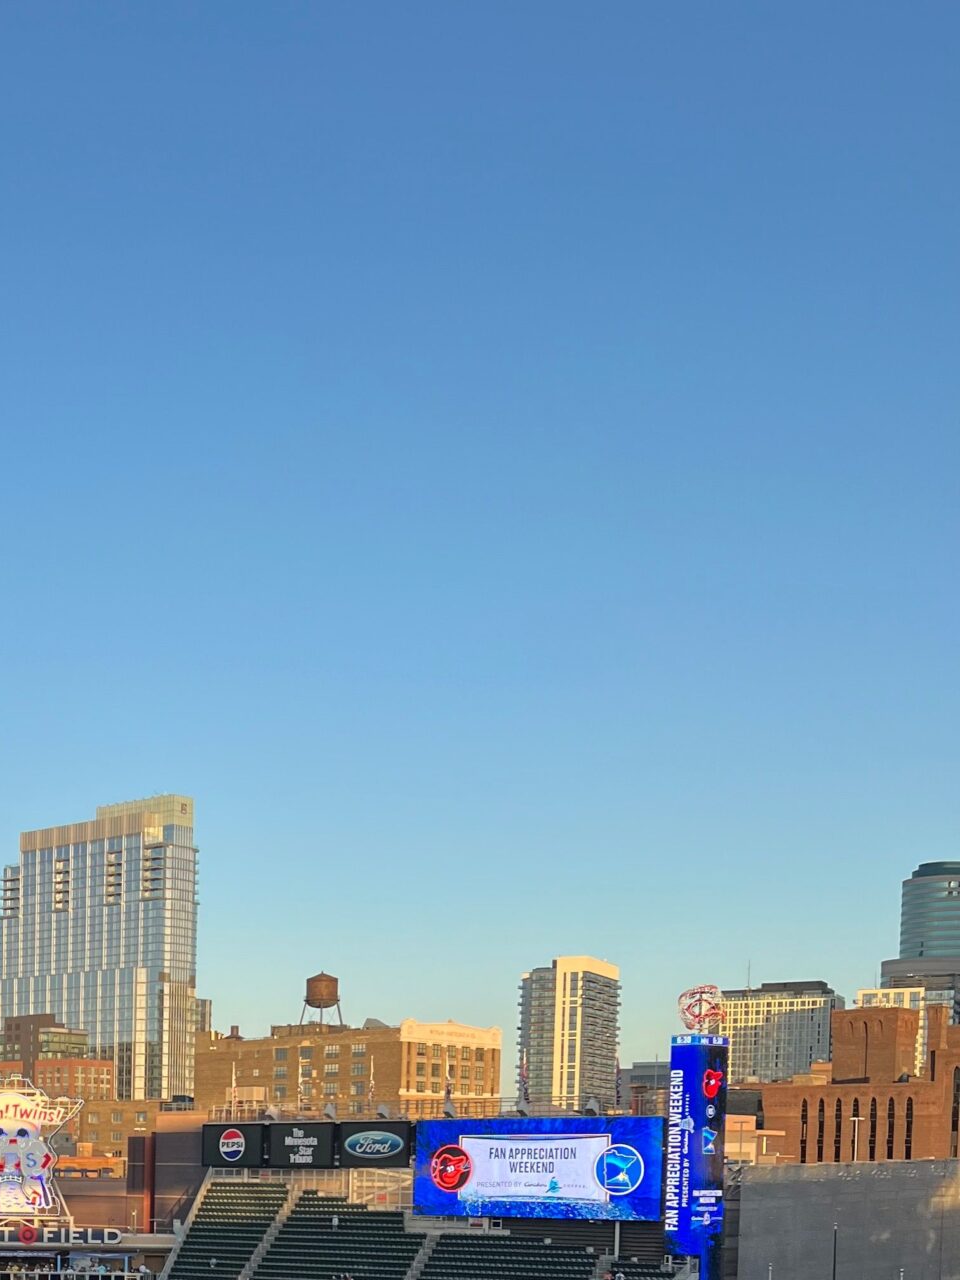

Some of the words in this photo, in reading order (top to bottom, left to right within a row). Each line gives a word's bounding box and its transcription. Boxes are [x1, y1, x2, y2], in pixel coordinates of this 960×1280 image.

[668, 1069, 684, 1126] WEEKEND
[12, 1101, 62, 1124] Twins!
[292, 1127, 305, 1138] The
[221, 1140, 244, 1149] PEPSI
[284, 1136, 318, 1146] Minnesota
[355, 1135, 391, 1153] Ford
[298, 1146, 314, 1156] Star
[489, 1147, 506, 1160] FAN
[508, 1147, 577, 1160] APPRECIATION
[289, 1154, 313, 1164] Tribune
[509, 1161, 555, 1174] WEEKEND
[666, 1126, 682, 1208] APPRECIATION
[665, 1209, 679, 1231] FAN
[42, 1227, 123, 1244] FIELD
